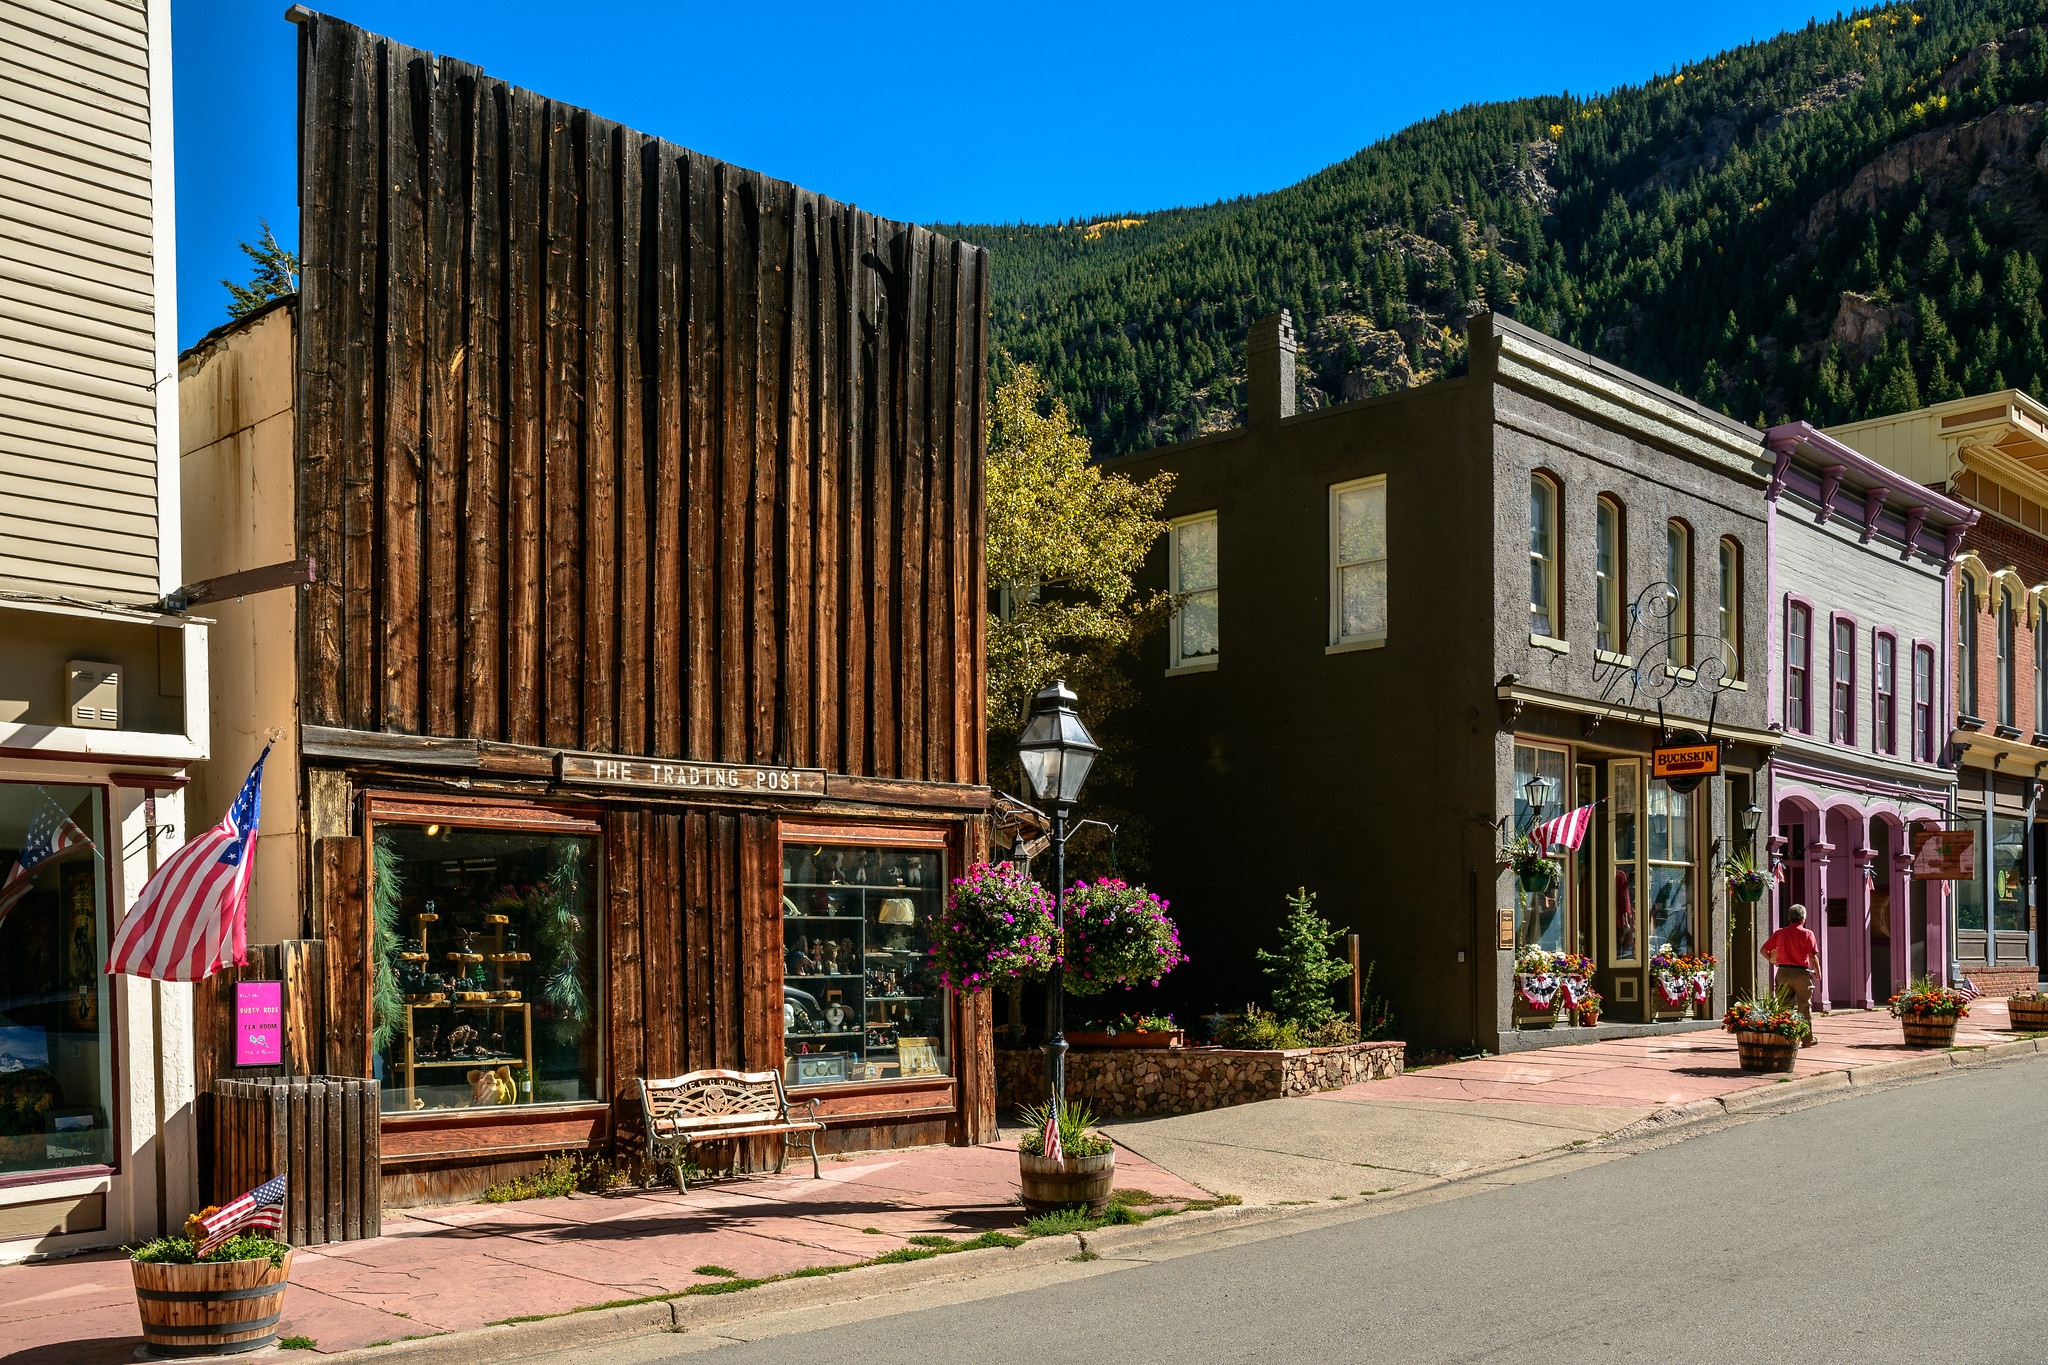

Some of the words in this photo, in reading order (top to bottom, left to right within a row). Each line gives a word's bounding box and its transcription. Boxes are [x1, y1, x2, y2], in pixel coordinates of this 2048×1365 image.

[1658, 751, 1714, 766] BUCKSKIN
[593, 760, 632, 781] THE
[650, 764, 738, 787] TRADING
[756, 771, 801, 791] POST
[263, 1006, 279, 1014] ROSE
[902, 1046, 938, 1069] OPEN
[680, 1079, 745, 1094] WELCOME
